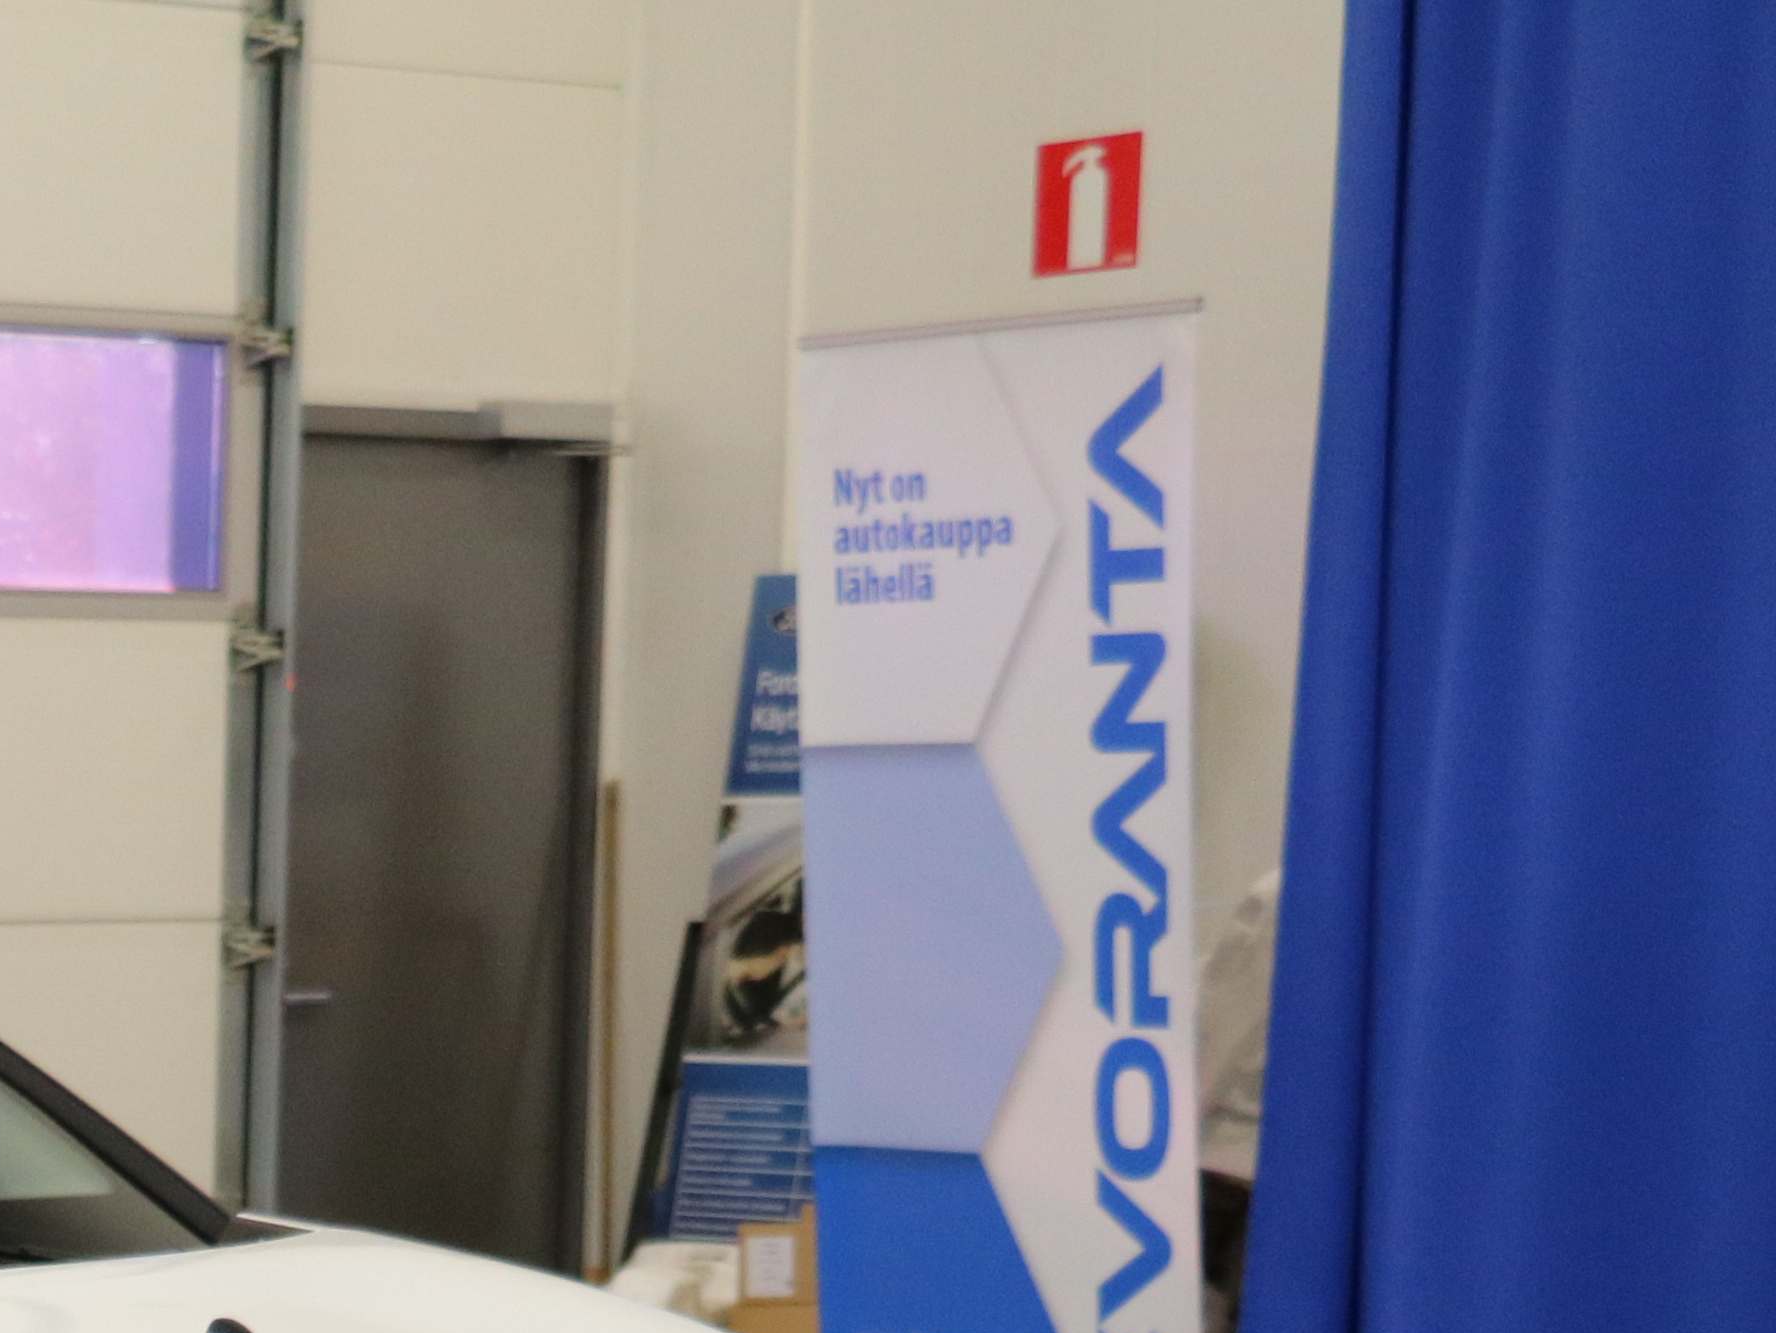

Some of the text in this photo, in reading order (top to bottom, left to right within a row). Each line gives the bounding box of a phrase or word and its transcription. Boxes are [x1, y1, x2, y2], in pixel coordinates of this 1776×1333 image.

[834, 468, 926, 515] Nyt on
[834, 512, 1013, 558] autokauppa
[835, 562, 934, 605] lähellä
